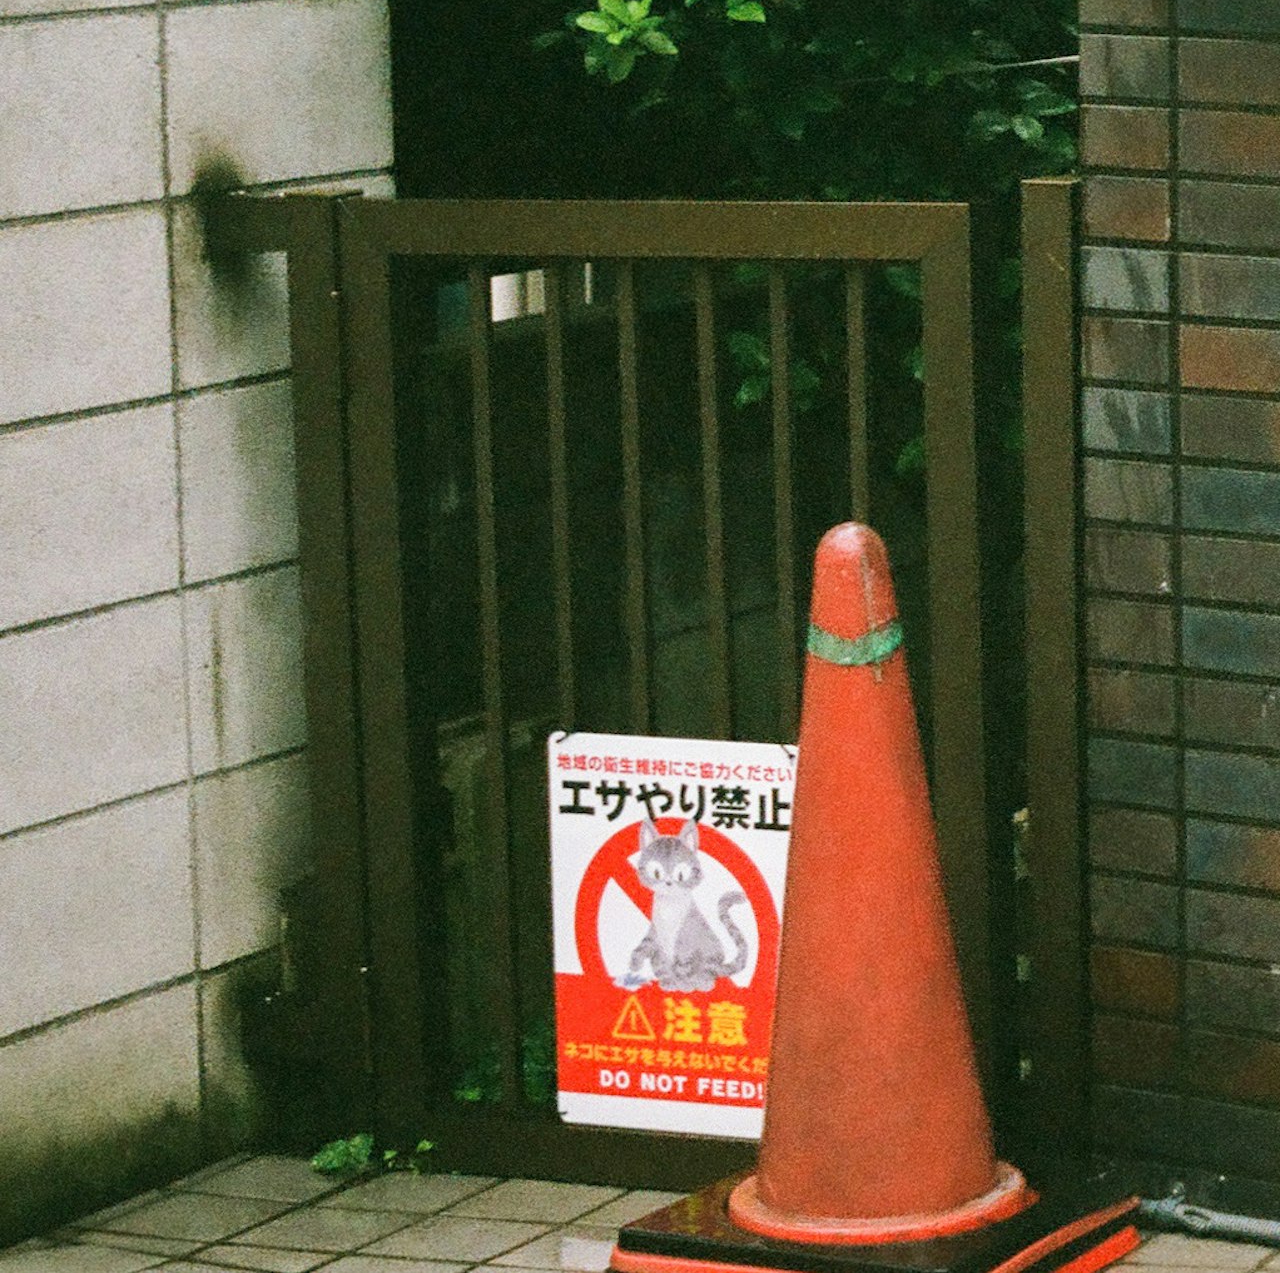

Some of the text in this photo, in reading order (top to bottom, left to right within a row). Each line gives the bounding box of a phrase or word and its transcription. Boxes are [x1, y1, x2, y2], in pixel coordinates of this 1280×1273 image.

[557, 753, 793, 783] 地域の衛生維持にご協力ください
[559, 780, 791, 832] エサやり禁止
[663, 996, 749, 1048] 注意
[599, 1069, 765, 1100] DO NOT FEED!
